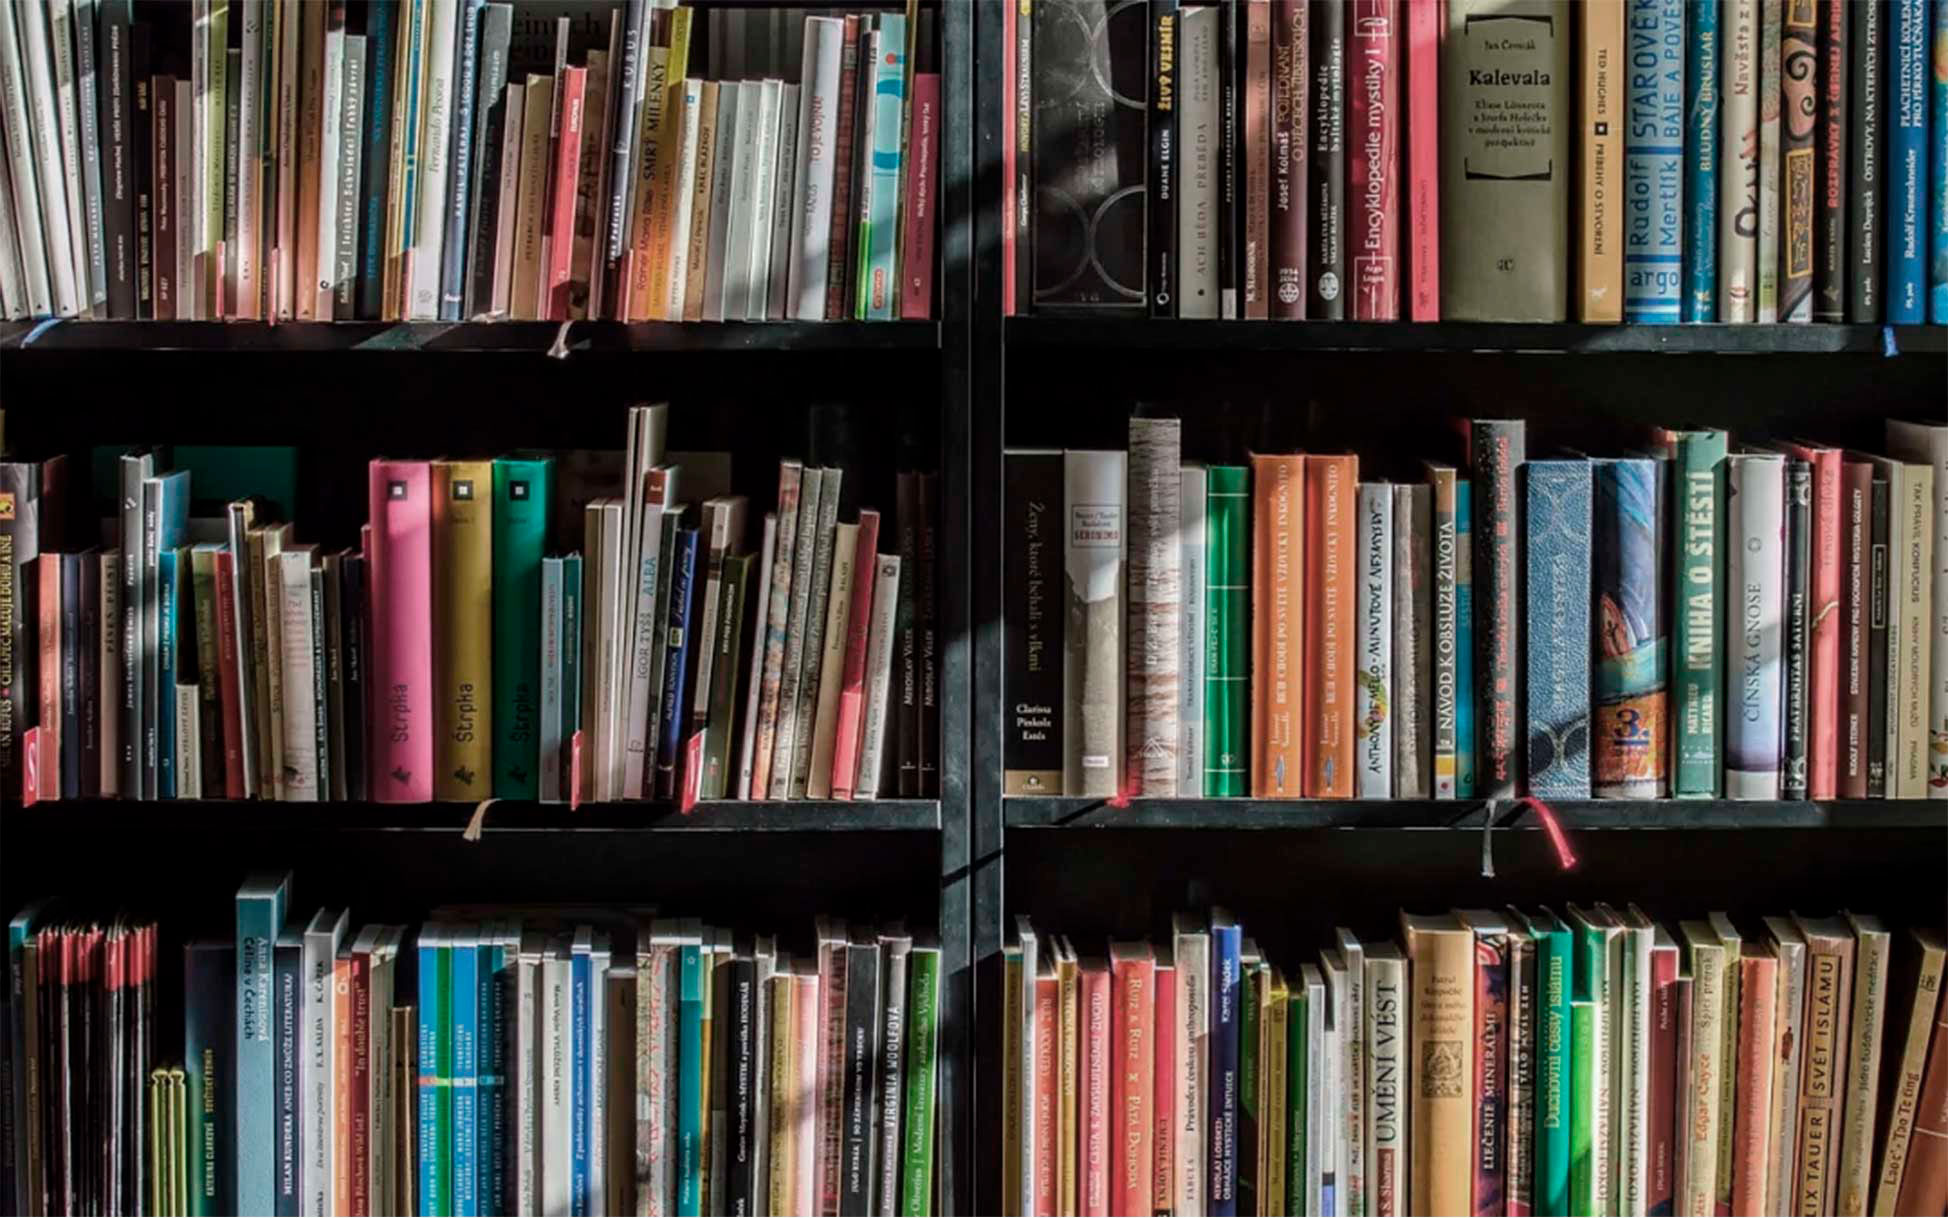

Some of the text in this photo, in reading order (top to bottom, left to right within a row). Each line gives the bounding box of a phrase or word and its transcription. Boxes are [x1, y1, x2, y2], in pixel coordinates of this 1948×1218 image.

[1469, 70, 1551, 86] Kalevala
[1598, 49, 1607, 69] TED
[1665, 70, 1680, 82] A
[647, 61, 665, 131] MILENKY
[1317, 65, 1330, 152] Encyklopedie
[1597, 72, 1606, 116] HUGHES
[1865, 105, 1874, 121] NA
[1161, 129, 1170, 160] ELGIN
[1365, 59, 1384, 249] Encyklopedie mystiky
[1160, 164, 1169, 199] DUANE
[1630, 160, 1650, 246] Rudolf
[1863, 232, 1873, 263] Lucien
[1905, 224, 1915, 258] Rudolf
[1630, 270, 1680, 294] argo
[1277, 464, 1288, 526] INKOGNITO
[1327, 464, 1338, 526] INKOGNITO
[1912, 482, 1923, 502] TAK
[1685, 471, 1714, 670] KNIHA O ŠTĚSTÍ
[1910, 542, 1921, 603] KONFUCIUS
[638, 557, 656, 679] IGOR ALBA
[1436, 522, 1453, 729] NÁVOD K OBSLUZE ŽIVOTA
[1740, 583, 1761, 722] ČÍNSKÁ GNOSE
[1791, 593, 1803, 741] FRATERNITAS SATURNI
[1016, 703, 1051, 714] Clarissa
[1849, 714, 1859, 745] STEINER
[1368, 718, 1382, 773] ANTHONY
[1849, 748, 1858, 776] RUDOLF
[1701, 957, 1713, 995] prorok
[244, 989, 256, 1039] Čechách
[1220, 995, 1230, 1022] Karel
[354, 1019, 367, 1055] double
[1544, 956, 1565, 1128] Duchovní cesty islámu
[884, 1006, 900, 1128] VIRGINIA WOOLFOVÁ
[1369, 979, 1397, 1143] UMĚNÍ VÉST
[1697, 1053, 1711, 1095] Cayce
[1807, 962, 1834, 1182] TAUER SVĚT ISLÁMU
[1481, 1013, 1497, 1169] LIEČENIE MINERÁLMI
[283, 1113, 293, 1161] KUNDERA
[913, 1114, 925, 1153] Moderní
[1224, 1071, 1233, 1199] OBHÁJCE MYSTICKÉ INTUICE
[1696, 1101, 1710, 1141] Edgar
[1893, 1117, 1908, 1140] Tao
[283, 1163, 293, 1195] MILAN
[1380, 1153, 1393, 1196] Sharma
